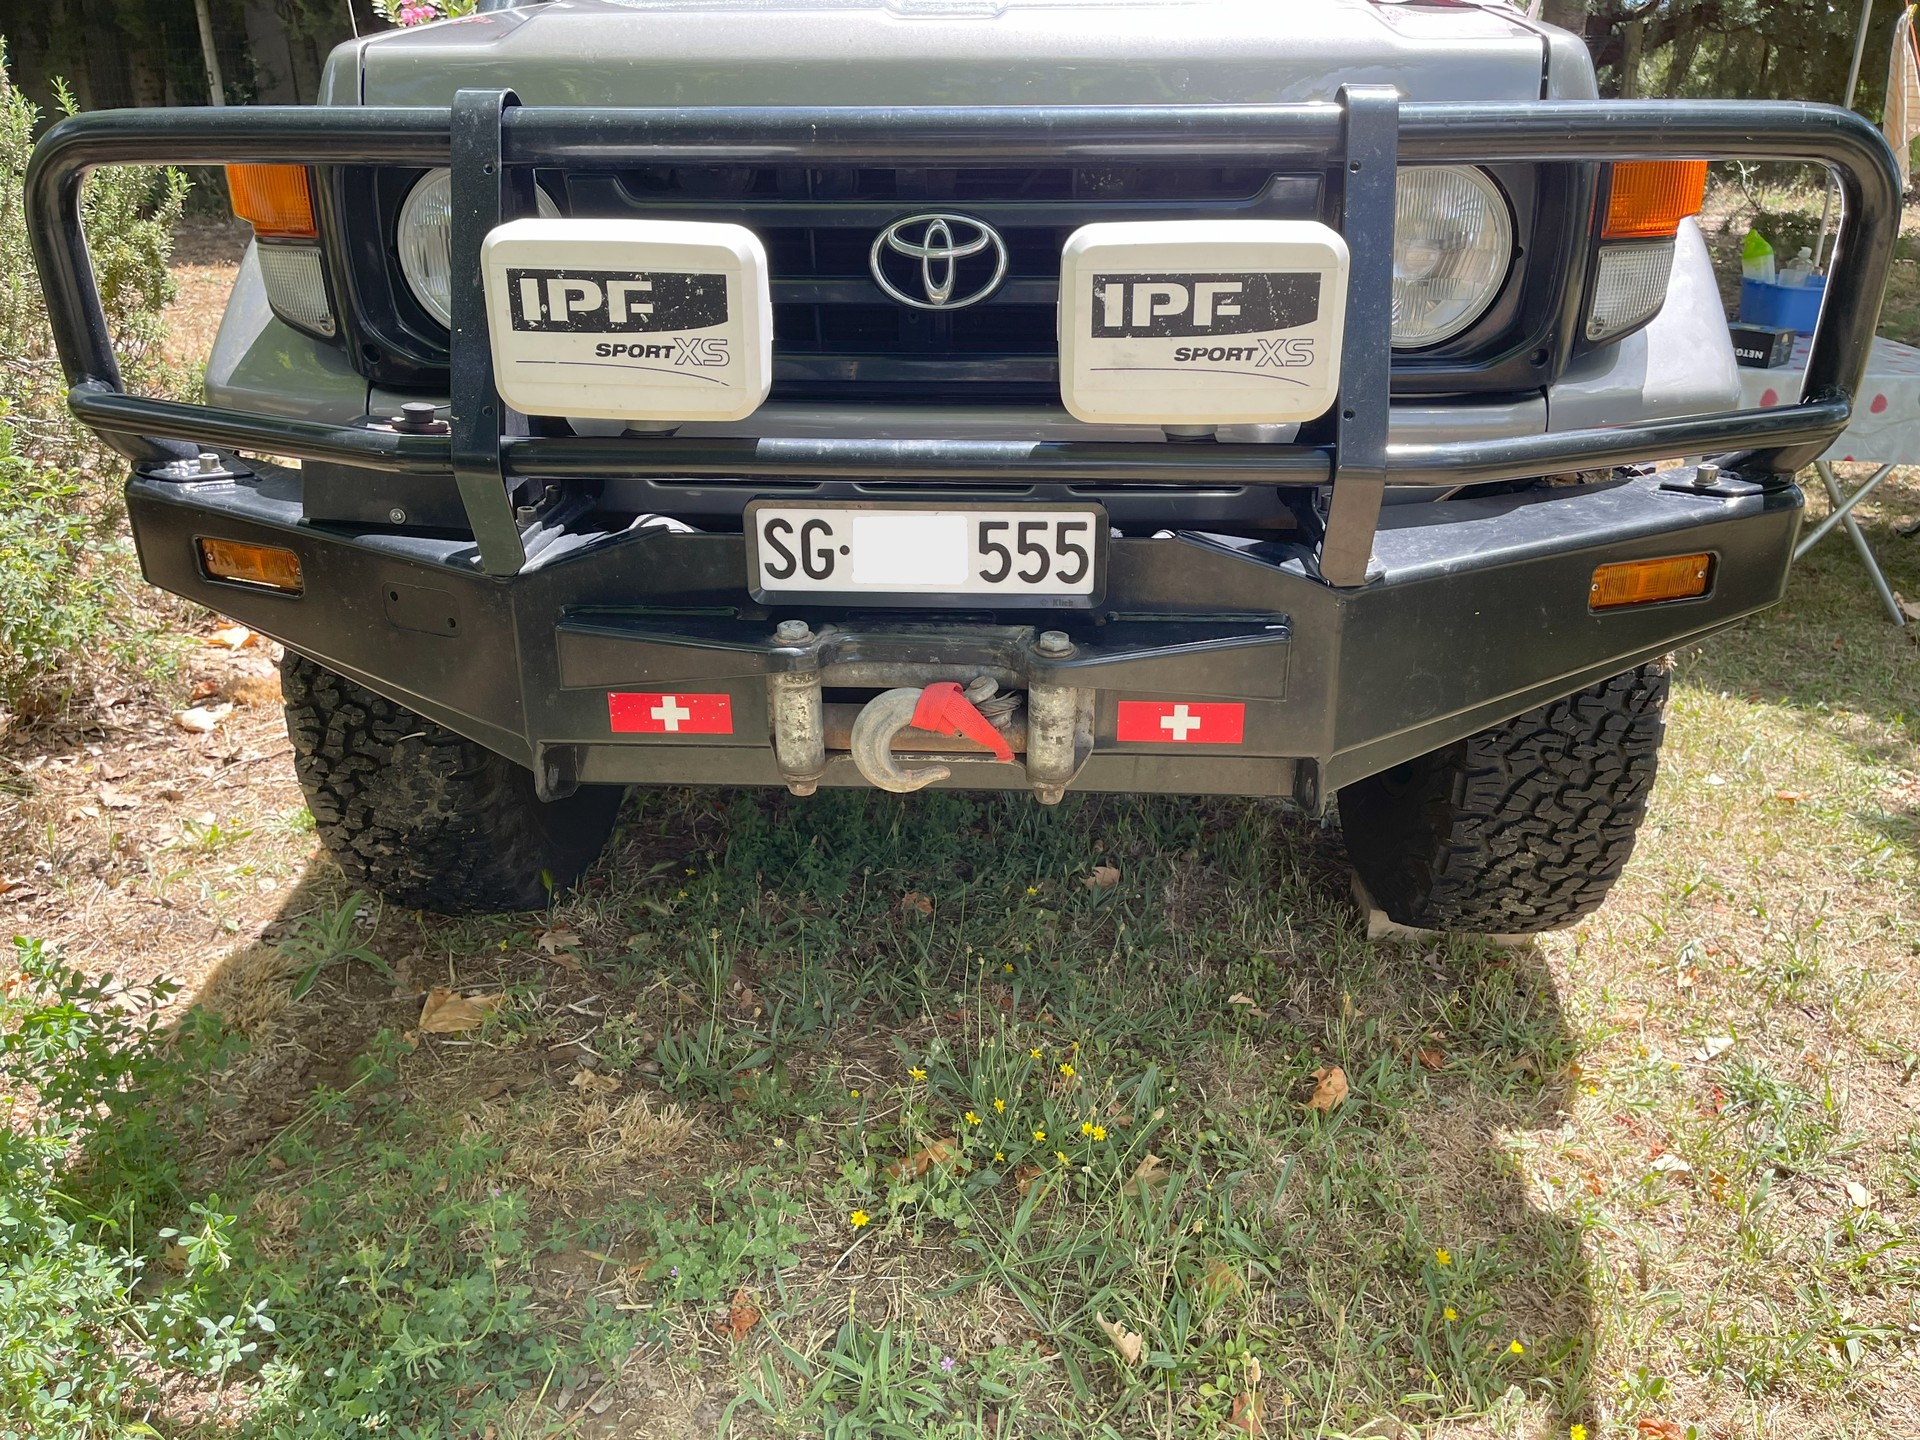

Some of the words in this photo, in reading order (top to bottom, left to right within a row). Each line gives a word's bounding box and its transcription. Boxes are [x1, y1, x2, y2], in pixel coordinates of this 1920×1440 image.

[519, 278, 654, 322] IPF
[1104, 281, 1242, 327] IPF
[1733, 348, 1764, 359] NETG
[979, 521, 1089, 584] 555
